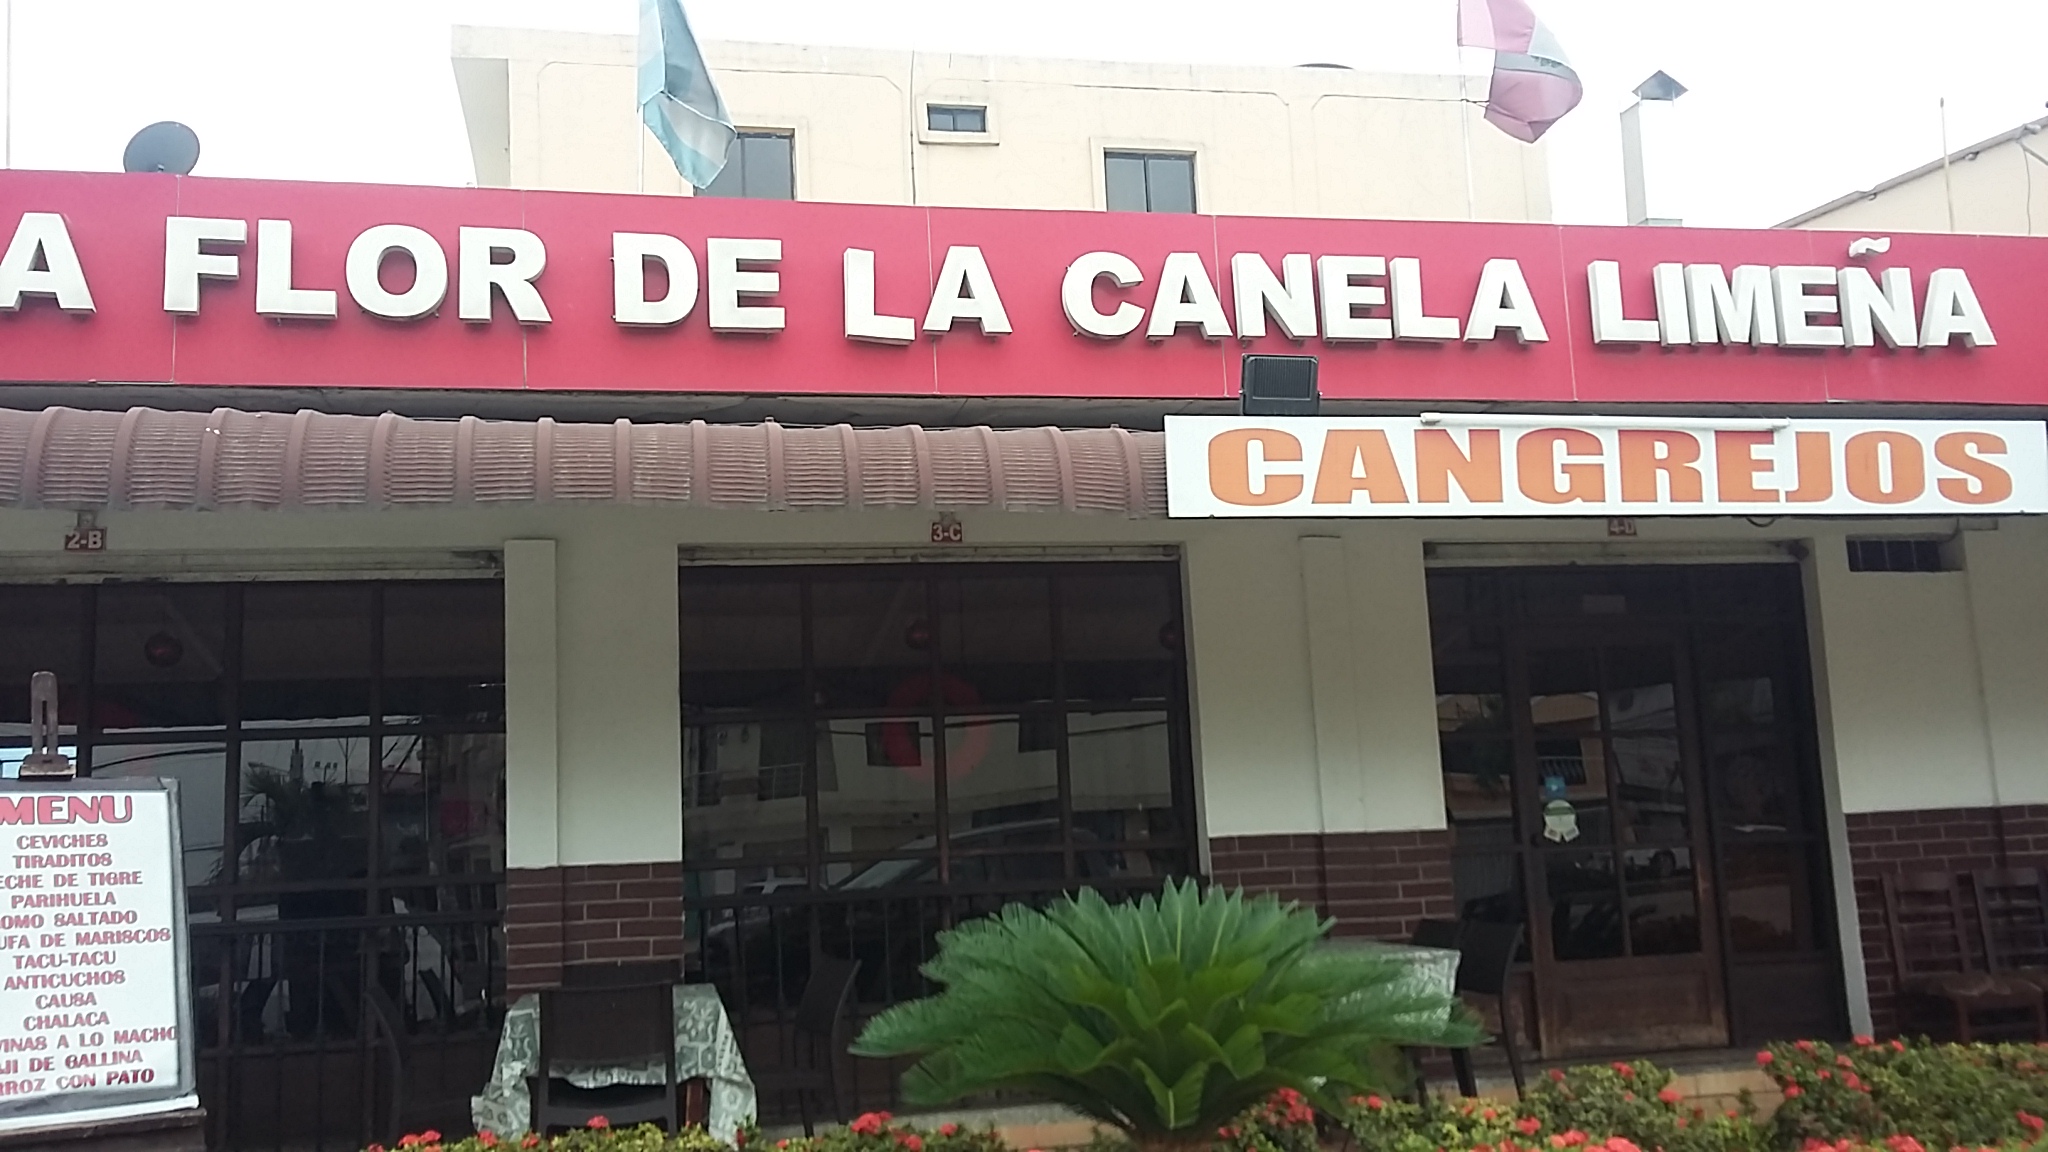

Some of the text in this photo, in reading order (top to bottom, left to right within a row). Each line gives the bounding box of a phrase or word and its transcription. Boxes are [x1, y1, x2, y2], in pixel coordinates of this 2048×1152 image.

[0, 212, 1997, 347] A FLOR DE LA CANELA LIMEÑA
[1207, 427, 2013, 505] CANGREJOS
[67, 530, 102, 549] 2-B
[933, 524, 961, 541] 3-C
[0, 796, 133, 825] MENU
[17, 834, 108, 849] CEVICHES
[13, 853, 112, 868] TIRADITOS
[54, 873, 78, 888] DE
[88, 871, 143, 886] TIGRE
[11, 892, 116, 908] PARIHUELA
[0, 910, 137, 930] OMO SALTADO
[40, 933, 66, 948] DE
[76, 927, 171, 946] MARISCOS
[13, 951, 116, 969] TACU-TACU
[4, 970, 126, 990] ANTICUCHOS
[36, 992, 97, 1009] CAUSA
[23, 1011, 110, 1031] CHALACA
[57, 1034, 69, 1049] A
[79, 1031, 104, 1047] LO
[114, 1026, 177, 1044] MACHO
[29, 1056, 55, 1072] DE
[65, 1050, 143, 1069] GALLINA
[56, 1073, 96, 1089] CON
[106, 1068, 154, 1085] PATO
